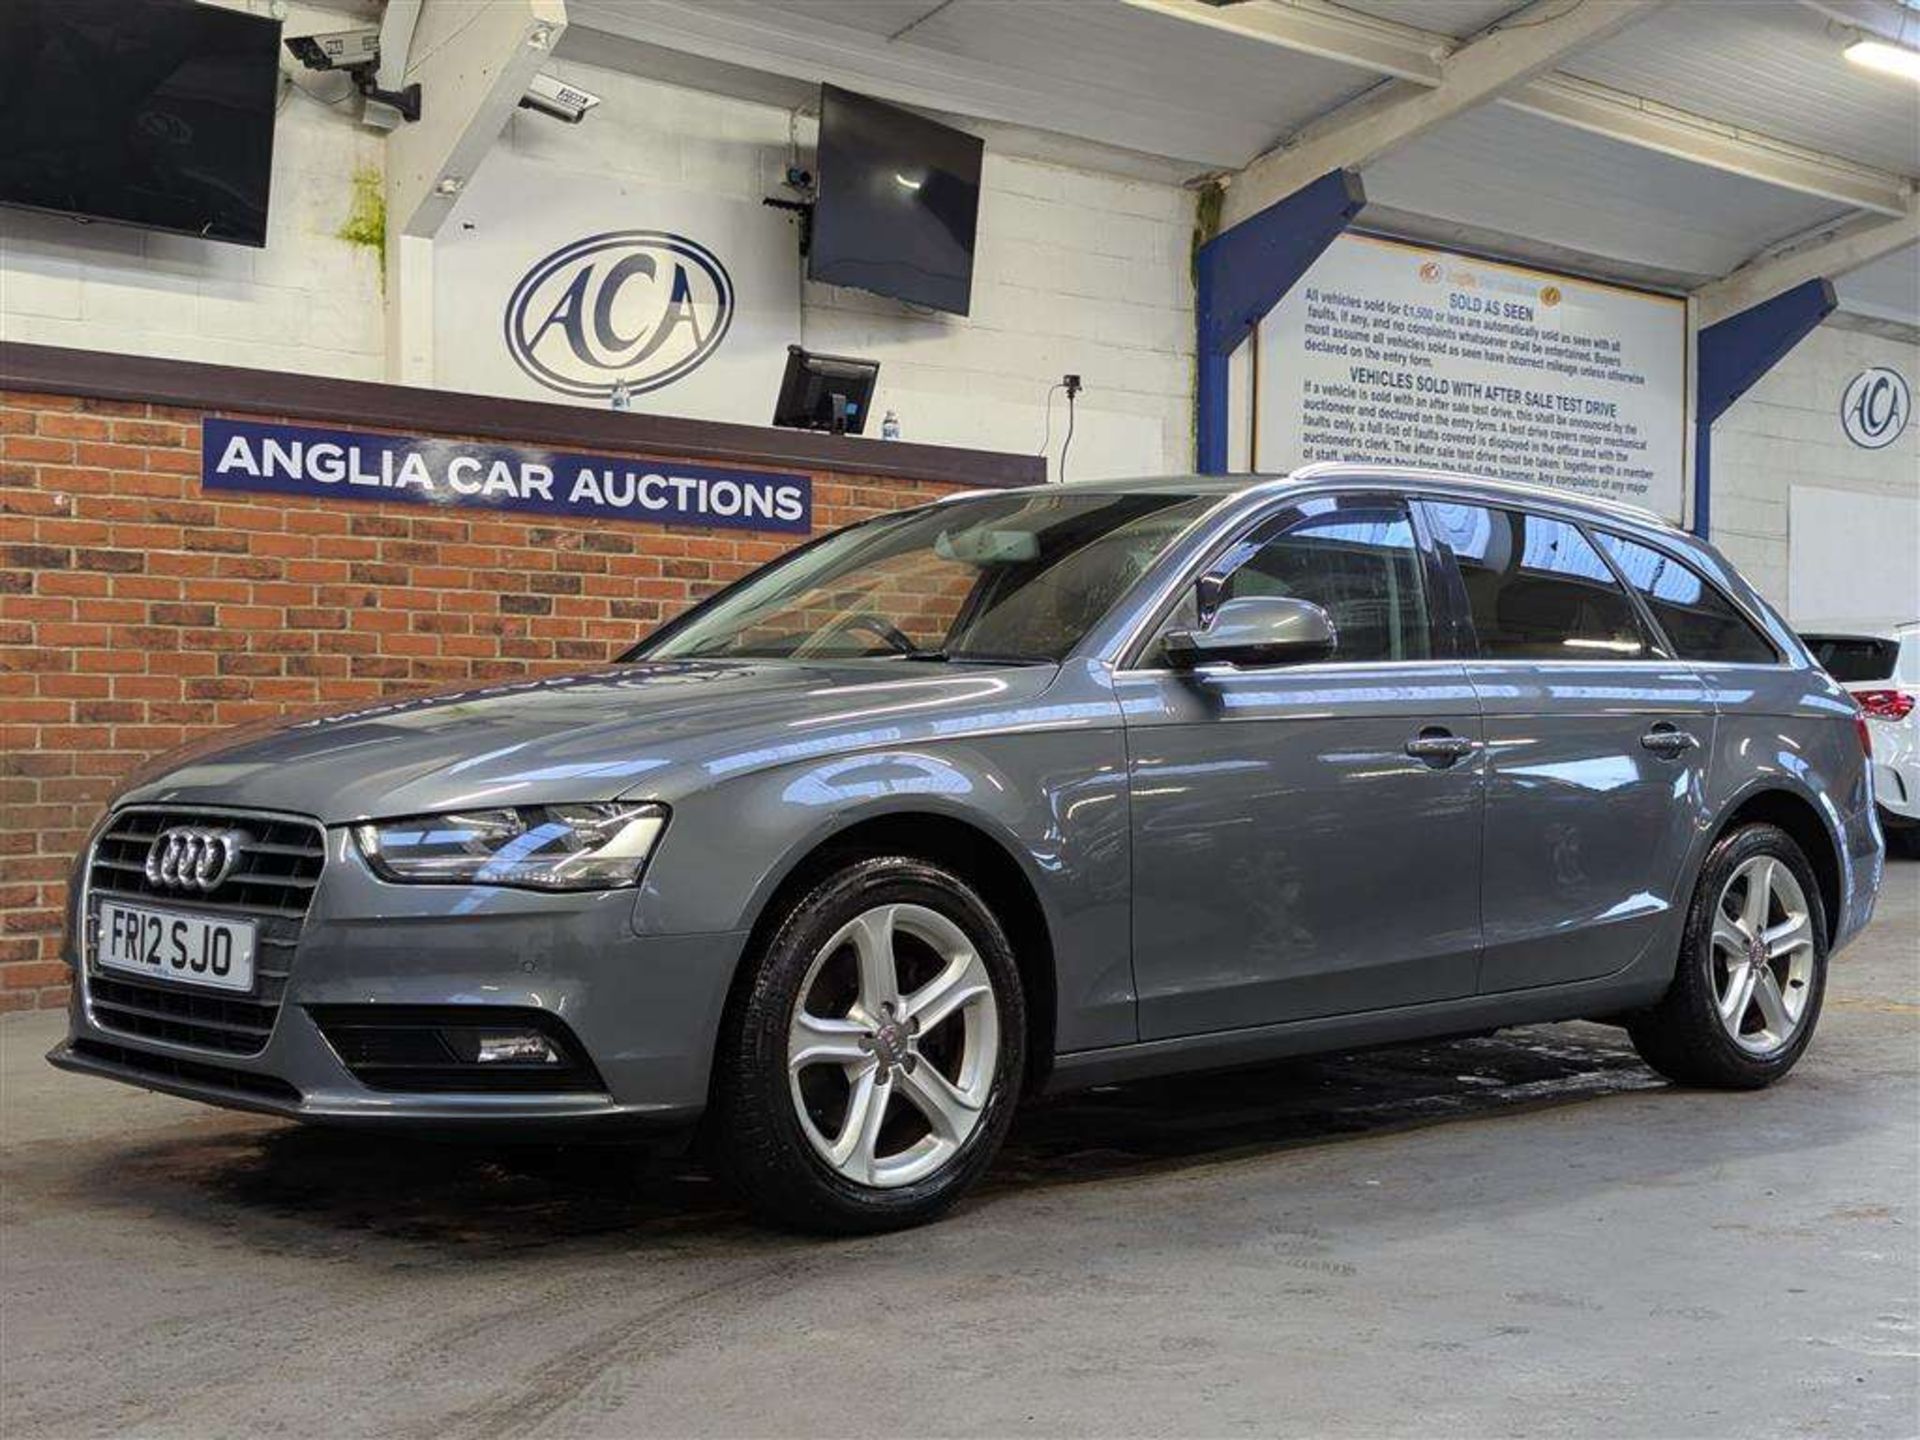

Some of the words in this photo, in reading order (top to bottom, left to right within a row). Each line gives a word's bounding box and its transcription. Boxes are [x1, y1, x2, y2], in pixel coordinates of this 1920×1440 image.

[527, 252, 703, 369] ACA
[1305, 288, 1319, 301] All
[1321, 292, 1361, 308] vehicles
[1364, 300, 1385, 312] sold
[1387, 302, 1402, 314] for
[1435, 312, 1444, 321] or
[1447, 314, 1464, 325] less
[1467, 317, 1481, 327] are
[1484, 319, 1539, 340] automatically
[1541, 330, 1559, 341] sold
[1562, 335, 1570, 343] as
[1573, 336, 1591, 347] seen
[1594, 338, 1609, 350] with
[1612, 340, 1620, 352] all
[1450, 292, 1481, 312] SOLD
[1485, 300, 1500, 315] AS
[1503, 303, 1534, 321] SEEN
[1305, 339, 1347, 355] declared
[1350, 346, 1362, 357] on
[1365, 347, 1380, 360] the
[1383, 351, 1407, 366] entry
[1305, 324, 1330, 336] must
[1332, 327, 1370, 342] assume
[1373, 333, 1384, 344] all
[1387, 335, 1425, 350] vehicles
[1428, 341, 1446, 354] sold
[1449, 346, 1459, 356] as
[1462, 347, 1481, 359] seen
[1485, 351, 1504, 363] have
[1507, 354, 1544, 369] incorrect
[1547, 359, 1578, 377] mileage
[1580, 367, 1605, 379] unless
[1607, 369, 1645, 385] otherwise
[1340, 309, 1348, 321] if
[1373, 318, 1390, 329] and
[1393, 321, 1405, 331] no
[1407, 322, 1456, 340] complaints
[1459, 330, 1508, 348] whatsoever
[1510, 338, 1530, 350] shall
[1532, 342, 1543, 353] be
[1595, 352, 1620, 368] Buyers
[1304, 379, 1311, 391] If
[1314, 384, 1319, 394] a
[1322, 384, 1356, 398] vehicle
[1359, 388, 1367, 400] is
[1370, 390, 1391, 403] sold
[1394, 393, 1413, 405] with
[1416, 398, 1426, 407] an
[1429, 398, 1449, 410] after
[1452, 401, 1469, 412] sale
[1472, 404, 1489, 415] test
[1517, 410, 1533, 421] this
[1535, 412, 1554, 424] shall
[1557, 415, 1566, 425] be
[1569, 417, 1611, 431] announced
[1614, 423, 1622, 434] by
[1625, 425, 1637, 435] the
[1350, 367, 1413, 389] VEHICLES
[1417, 375, 1448, 394] SOLD
[1452, 380, 1481, 398] WITH
[1485, 386, 1521, 404] AFTER
[1525, 391, 1553, 409] SALE
[1556, 395, 1583, 412] TEST
[1586, 400, 1616, 418] DRIVE
[1847, 377, 1900, 437] ACA
[1302, 413, 1331, 428] faults
[1359, 424, 1365, 432] a
[1367, 421, 1382, 433] full
[1385, 424, 1400, 436] list
[1402, 426, 1412, 437] of
[1414, 427, 1438, 441] faults
[1441, 432, 1476, 445] covered
[1479, 436, 1486, 446] is
[1488, 437, 1529, 451] displayed
[1531, 442, 1539, 451] in
[1541, 442, 1554, 454] the
[1557, 444, 1579, 456] office
[1582, 448, 1595, 458] and
[1598, 450, 1613, 460] with
[1616, 451, 1628, 461] the
[1303, 399, 1356, 414] auctioneer
[1358, 406, 1376, 417] and
[1378, 408, 1419, 423] declared
[1421, 414, 1433, 424] on
[1435, 415, 1449, 426] the
[1451, 417, 1474, 432] entry
[1501, 422, 1507, 432] A
[1509, 423, 1525, 435] test
[1527, 426, 1548, 438] drive
[1551, 430, 1578, 442] covers
[1580, 433, 1602, 446] major
[1604, 436, 1647, 450] mechanical
[216, 436, 434, 490] ANGLIA
[448, 457, 554, 500] CAR
[569, 469, 803, 520] AUCTIONS
[1302, 446, 1313, 458] of
[1343, 451, 1372, 463] within
[1419, 458, 1439, 468] from
[1441, 461, 1455, 471] the
[1457, 462, 1471, 472] fall
[1474, 464, 1483, 473] of
[1484, 464, 1498, 476] the
[1539, 471, 1553, 485] Any
[1556, 474, 1600, 489] complaints
[1601, 479, 1609, 490] of
[1612, 480, 1623, 493] any
[1627, 482, 1648, 495] major
[1394, 440, 1410, 453] The
[1414, 442, 1434, 455] after
[1437, 447, 1455, 458] sale
[1457, 449, 1473, 460] test
[1475, 450, 1497, 463] drive
[1500, 454, 1520, 465] must
[1523, 455, 1533, 466] be
[1564, 460, 1596, 474] together
[1599, 465, 1615, 475] with
[1616, 467, 1620, 476] a
[1623, 467, 1653, 479] member
[111, 910, 162, 966] FR12
[171, 920, 232, 976] SJO
